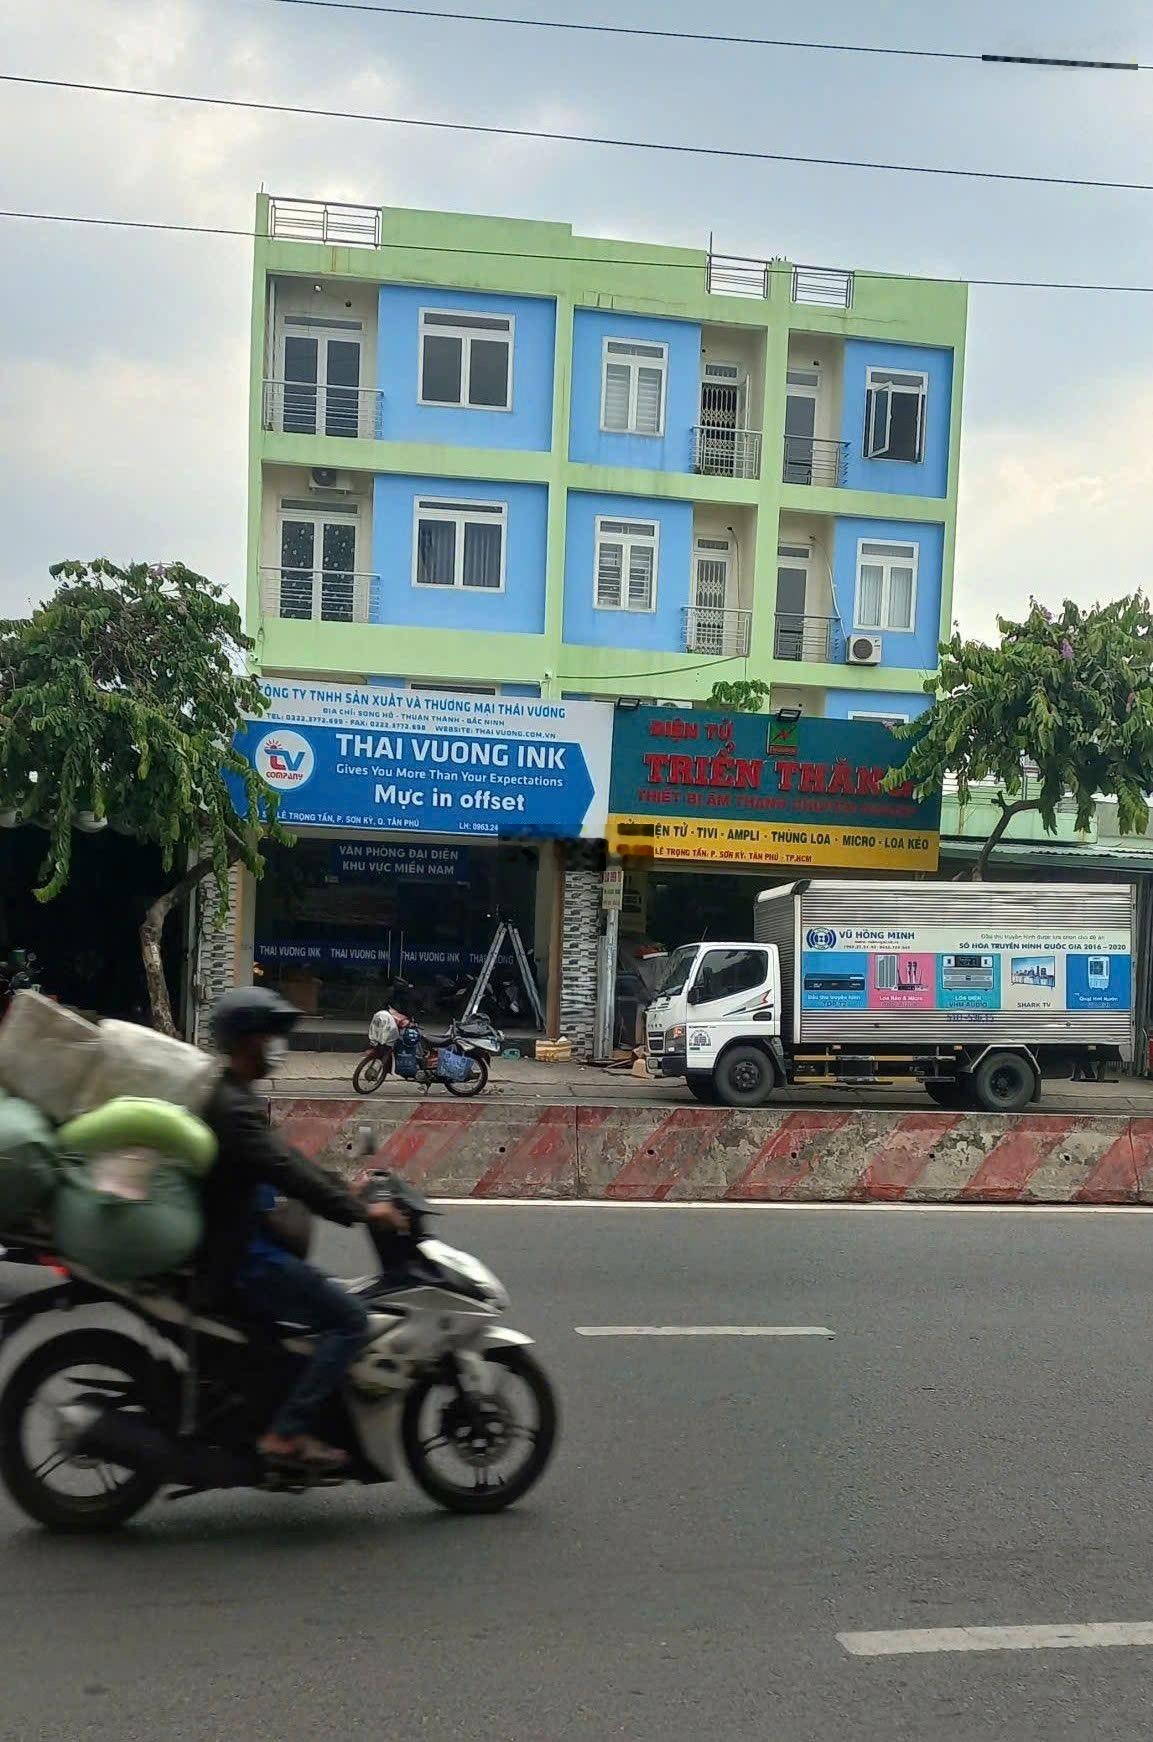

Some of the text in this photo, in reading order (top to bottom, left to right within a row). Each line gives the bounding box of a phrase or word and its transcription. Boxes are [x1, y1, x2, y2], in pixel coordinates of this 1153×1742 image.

[292, 688, 307, 700] TY
[310, 690, 342, 702] TNHH
[346, 690, 369, 705] SẢN
[406, 696, 421, 709] VÀ
[425, 698, 471, 713] THƯƠNG
[474, 703, 494, 716] MẠI
[498, 703, 524, 716] THÁI
[527, 705, 566, 719] VƯƠNG
[358, 710, 379, 718] SONG
[650, 718, 734, 741] ĐIỆN TỬ
[336, 733, 567, 770] THAI VUONG INK
[643, 742, 764, 789] TRIỂN
[336, 763, 564, 787] Gives You More Than Your Expectations
[375, 784, 525, 811] Mực in offset
[289, 812, 316, 821] TRỌNG
[336, 815, 344, 823] P.
[404, 818, 419, 828] PHÚ
[674, 822, 689, 838] TỬ
[697, 826, 718, 839] TIVI
[727, 829, 760, 842] AMPLI
[771, 828, 807, 844] THÙNG
[810, 833, 831, 845] LOA
[842, 834, 876, 847] MICRO
[885, 837, 904, 848] LOA
[908, 835, 929, 850] KÉO
[339, 845, 362, 856] VĂN
[366, 845, 406, 858] PHÒNG
[431, 847, 459, 861] DIỆN
[667, 848, 690, 858] TRỌNG
[711, 849, 717, 857] P.
[765, 850, 779, 861] PHÚ
[785, 854, 812, 863] TP.HCM
[343, 860, 454, 875] KHU VỰC MIỀN NAM
[839, 929, 915, 940] VŨ HỒNG MINH
[260, 945, 321, 957] THAI VUONG INK
[331, 948, 348, 958] THAI
[350, 949, 376, 960] VUONG
[419, 951, 445, 962] VUONG
[447, 952, 460, 963] INK
